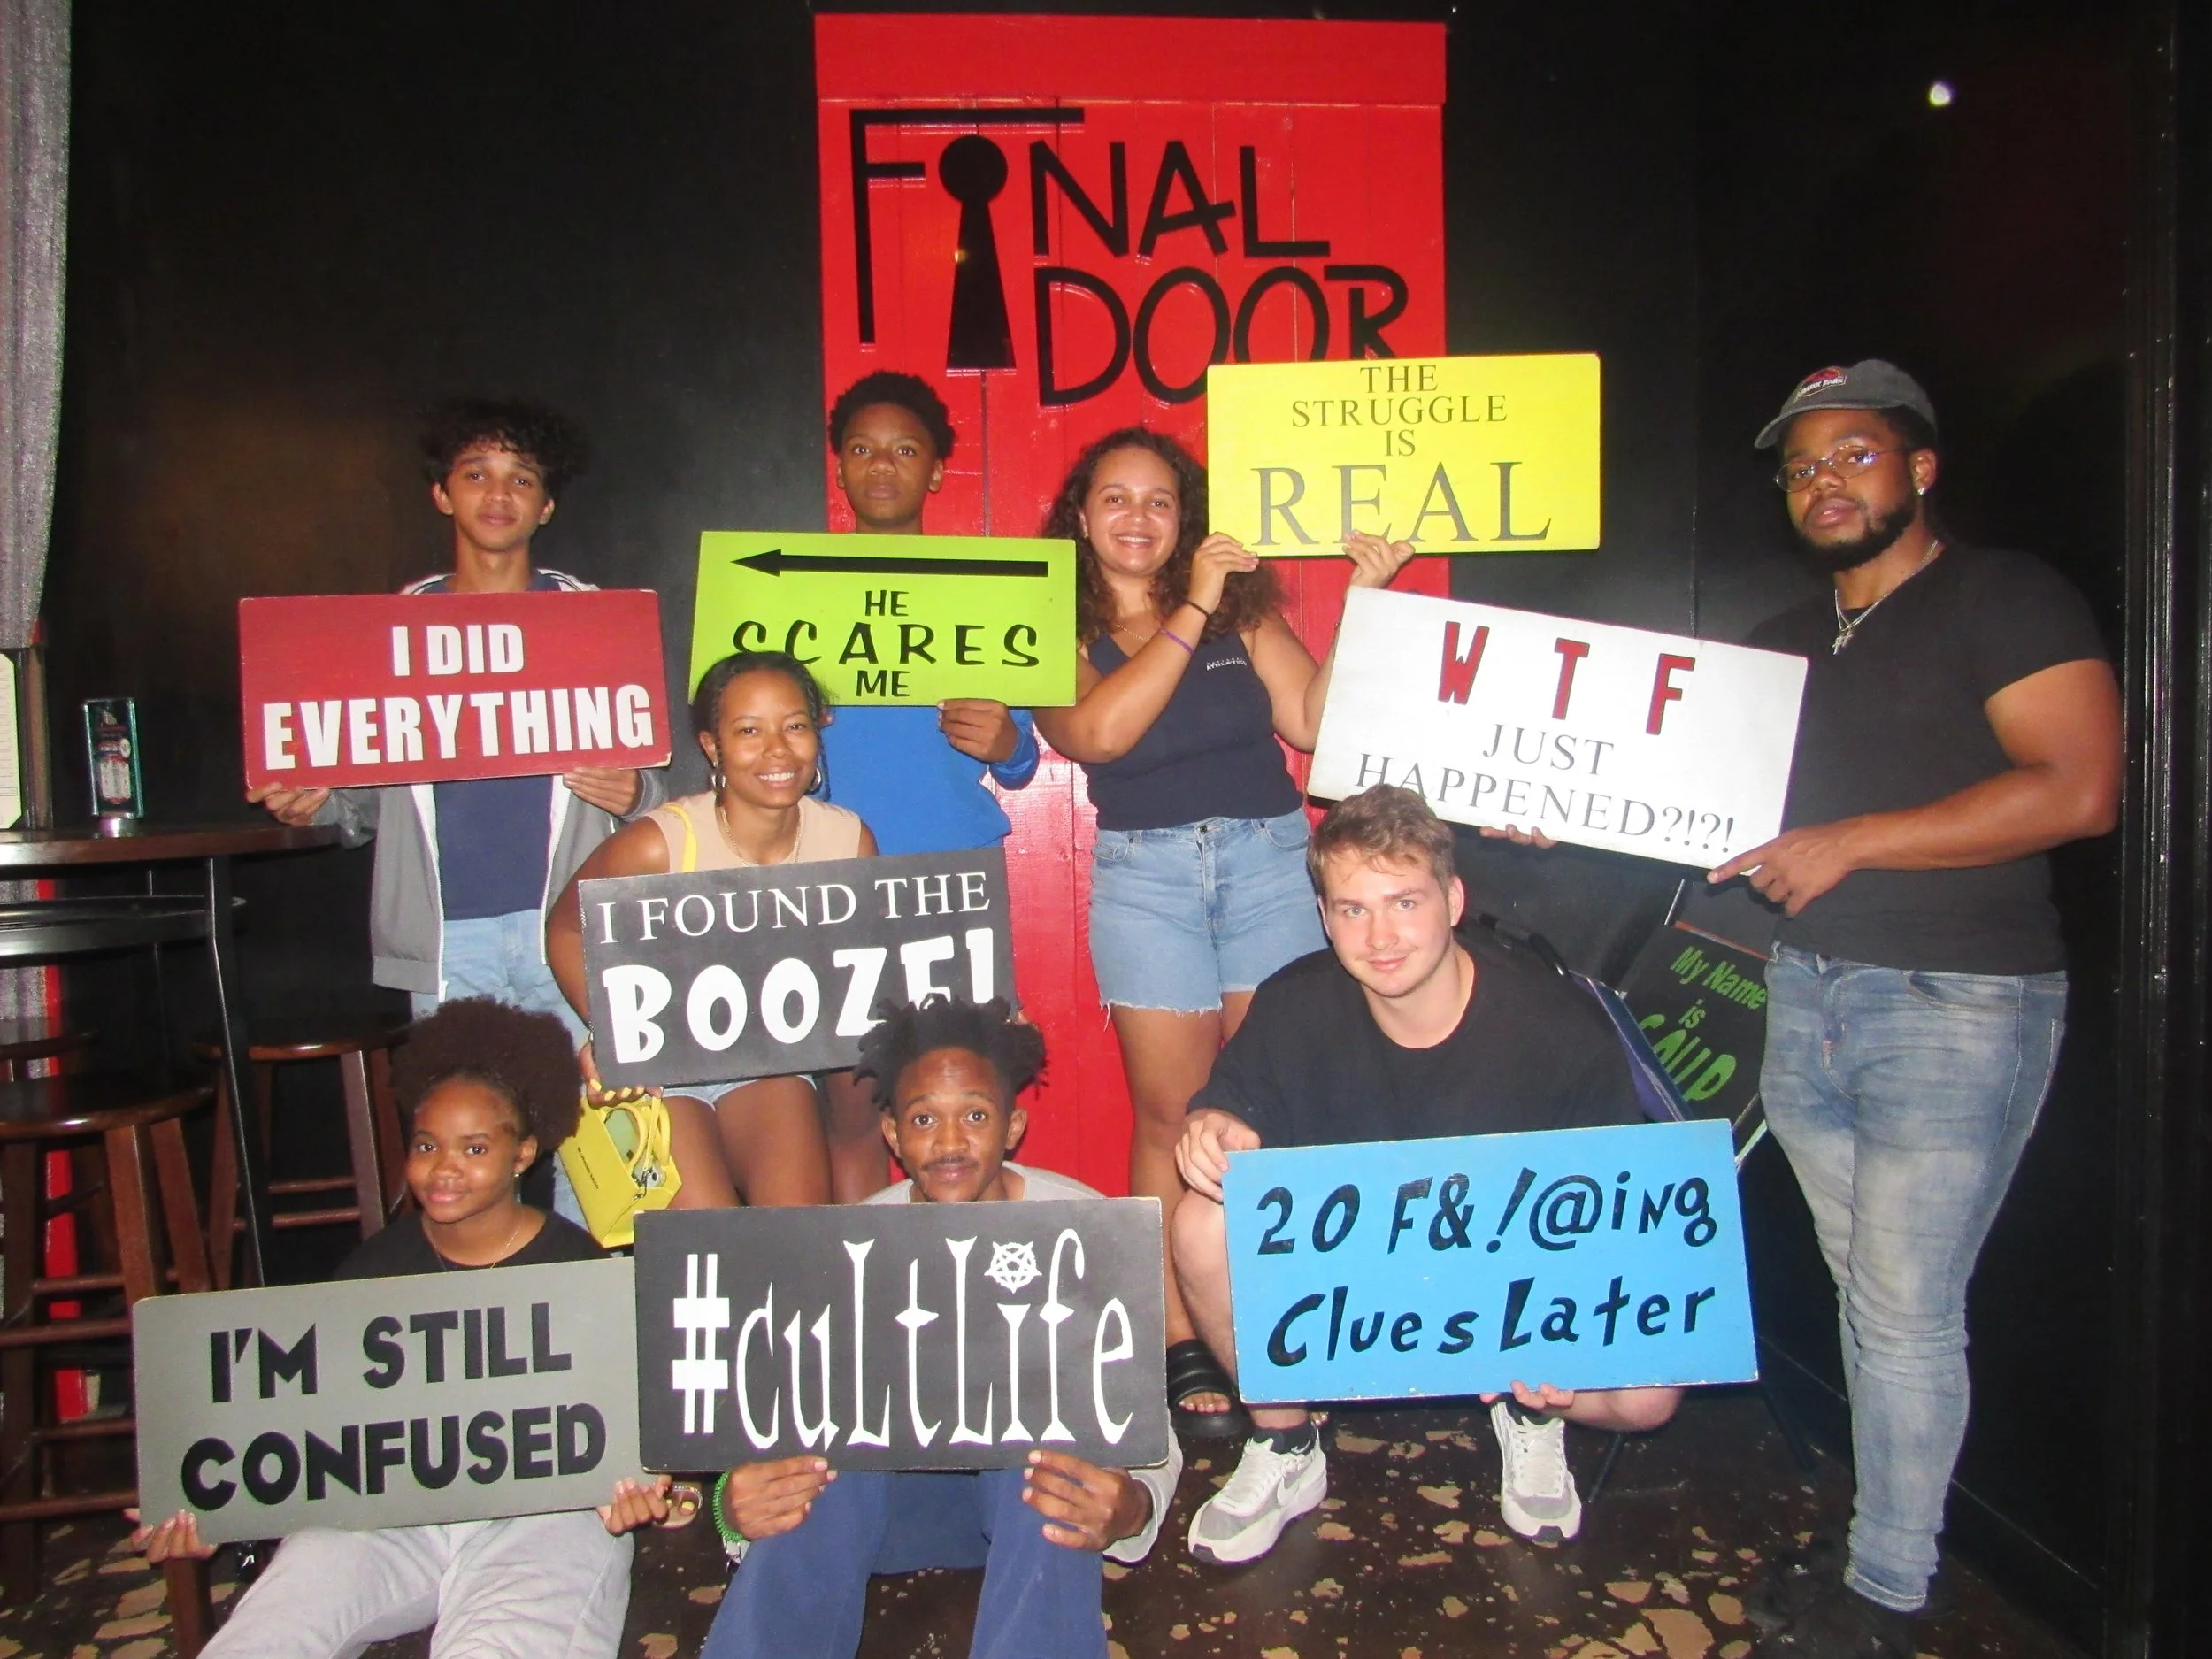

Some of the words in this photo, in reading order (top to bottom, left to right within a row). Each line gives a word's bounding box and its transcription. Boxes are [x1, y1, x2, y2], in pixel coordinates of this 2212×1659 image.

[1033, 265, 1409, 407] DOOR
[1292, 395, 1508, 428] STRUGGLE
[1360, 365, 1438, 394] THE
[1385, 429, 1416, 457] IS
[1250, 461, 1552, 546] REAL
[864, 590, 910, 617] HE
[392, 626, 410, 676] I
[426, 624, 525, 676] DID
[733, 620, 1040, 667] SCARES
[856, 670, 910, 697] ME
[263, 684, 654, 770] EVERYTHING
[1482, 724, 1614, 776] JUST
[1355, 753, 1734, 853] HAPPENED?!?!
[597, 902, 618, 944] I
[637, 883, 856, 941] FOUND
[874, 872, 991, 919] THE
[1670, 946, 1709, 984] My
[1703, 960, 1767, 1010] Name
[1678, 999, 1706, 1028] is
[1256, 1183, 1361, 1255] 20
[210, 1323, 318, 1403] I'M
[362, 1302, 572, 1389] STILL
[1266, 1286, 1479, 1367] Clues
[1499, 1275, 1716, 1353] Later
[180, 1402, 606, 1511] CONFUSED
